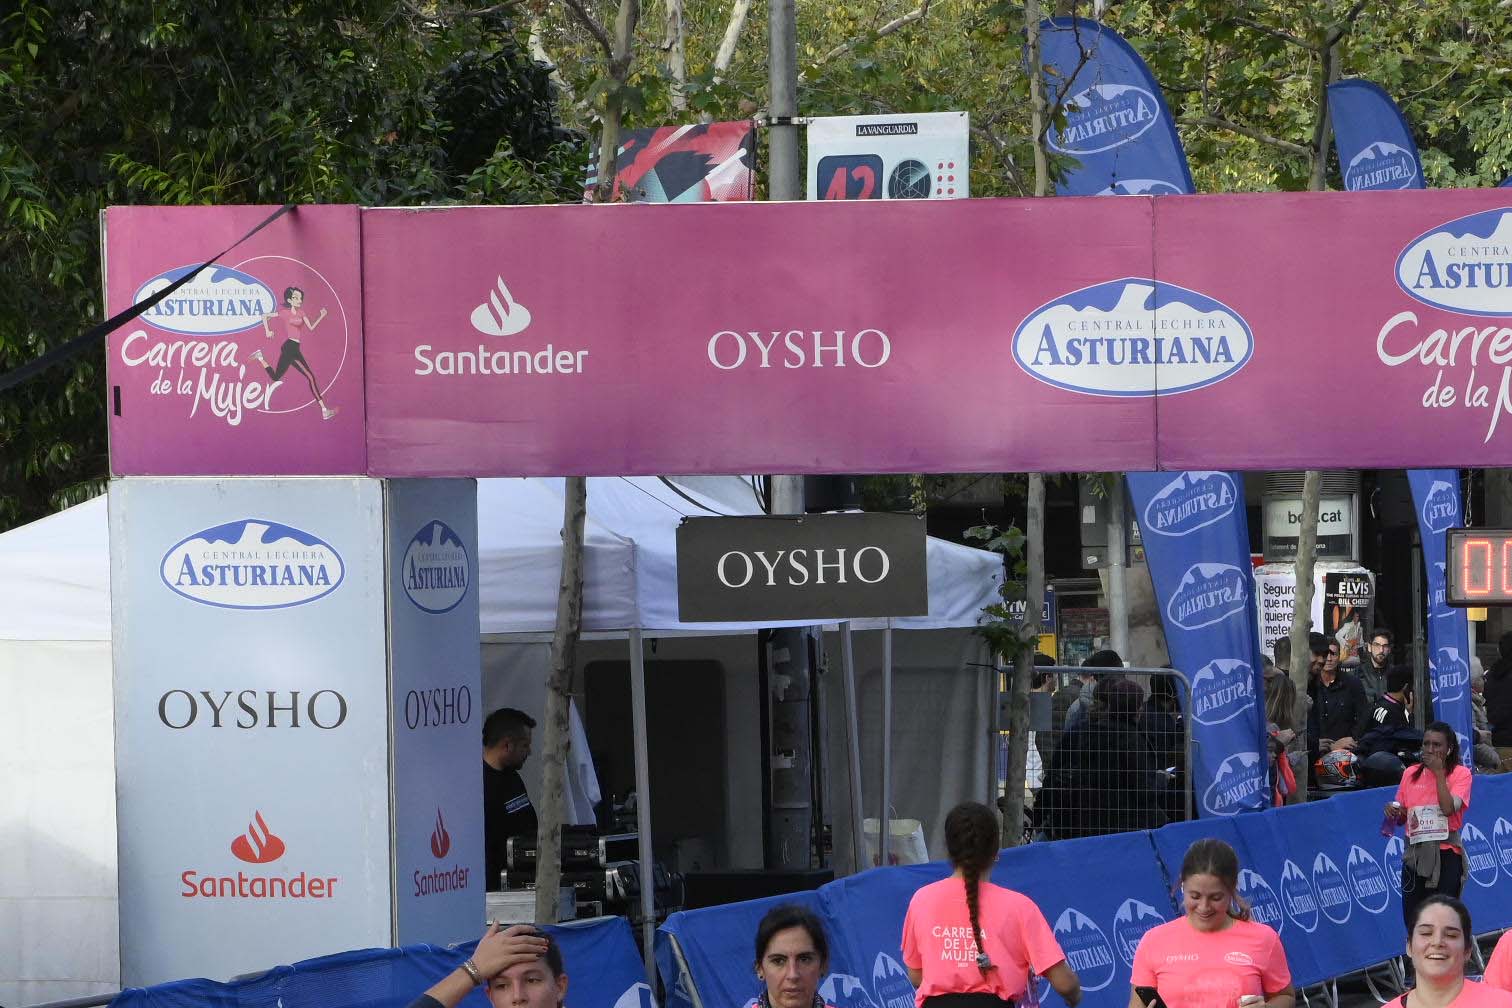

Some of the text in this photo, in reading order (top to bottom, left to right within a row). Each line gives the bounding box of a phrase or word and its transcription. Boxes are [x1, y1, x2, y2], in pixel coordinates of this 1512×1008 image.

[1067, 318, 1227, 332] CENTRAL LECHERA
[120, 330, 239, 368] Carrera
[413, 342, 589, 378] Santander
[707, 328, 892, 370] OYSHO
[1031, 322, 1235, 366] ASTURIANA
[150, 362, 284, 426] de la Mujer
[1421, 370, 1457, 409] de
[1464, 368, 1489, 409] la
[174, 552, 332, 588] ASTURIANA
[202, 550, 325, 561] CENTRAL LECHERA
[407, 555, 466, 591] ASTURIANA
[716, 546, 891, 589] OYSHO
[1264, 598, 1280, 610] que
[1338, 581, 1369, 595] ELVIS
[157, 688, 348, 730] OYSHO
[404, 684, 472, 730] OYSHO
[181, 869, 338, 899] Santander
[413, 864, 470, 898] Santander
[932, 926, 987, 940] CARREA
[944, 938, 960, 950] DE
